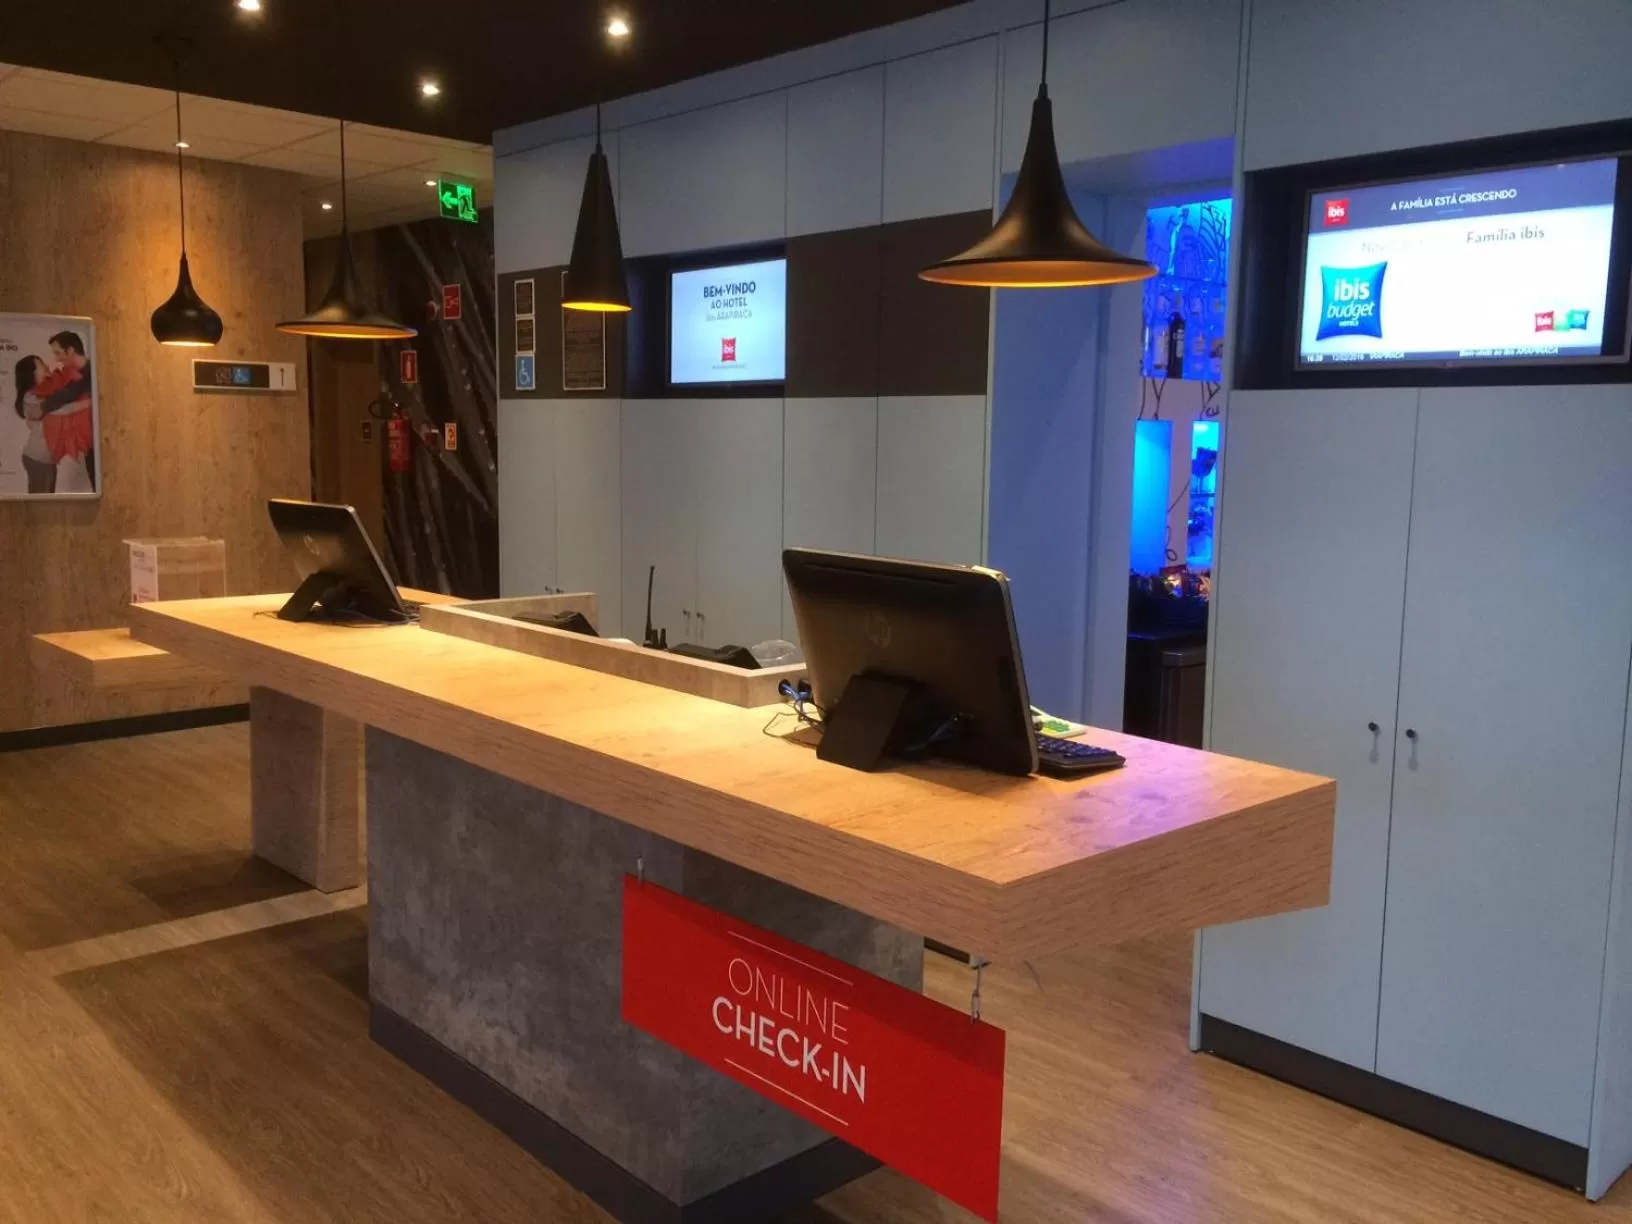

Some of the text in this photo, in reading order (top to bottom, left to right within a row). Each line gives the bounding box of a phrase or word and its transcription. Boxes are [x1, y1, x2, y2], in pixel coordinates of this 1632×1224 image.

[1390, 188, 1518, 211] A FAMÍLIA ESTÁ CRESCENDO
[1327, 203, 1346, 217] ibis
[1520, 225, 1545, 240] ibis
[703, 281, 756, 298] BEM-VINDO
[1334, 278, 1371, 301] ibis
[711, 297, 748, 310] AO HOTEL
[1327, 301, 1375, 320] budget
[728, 957, 851, 1045] ONLINE
[711, 995, 867, 1105] CHECK-IN
